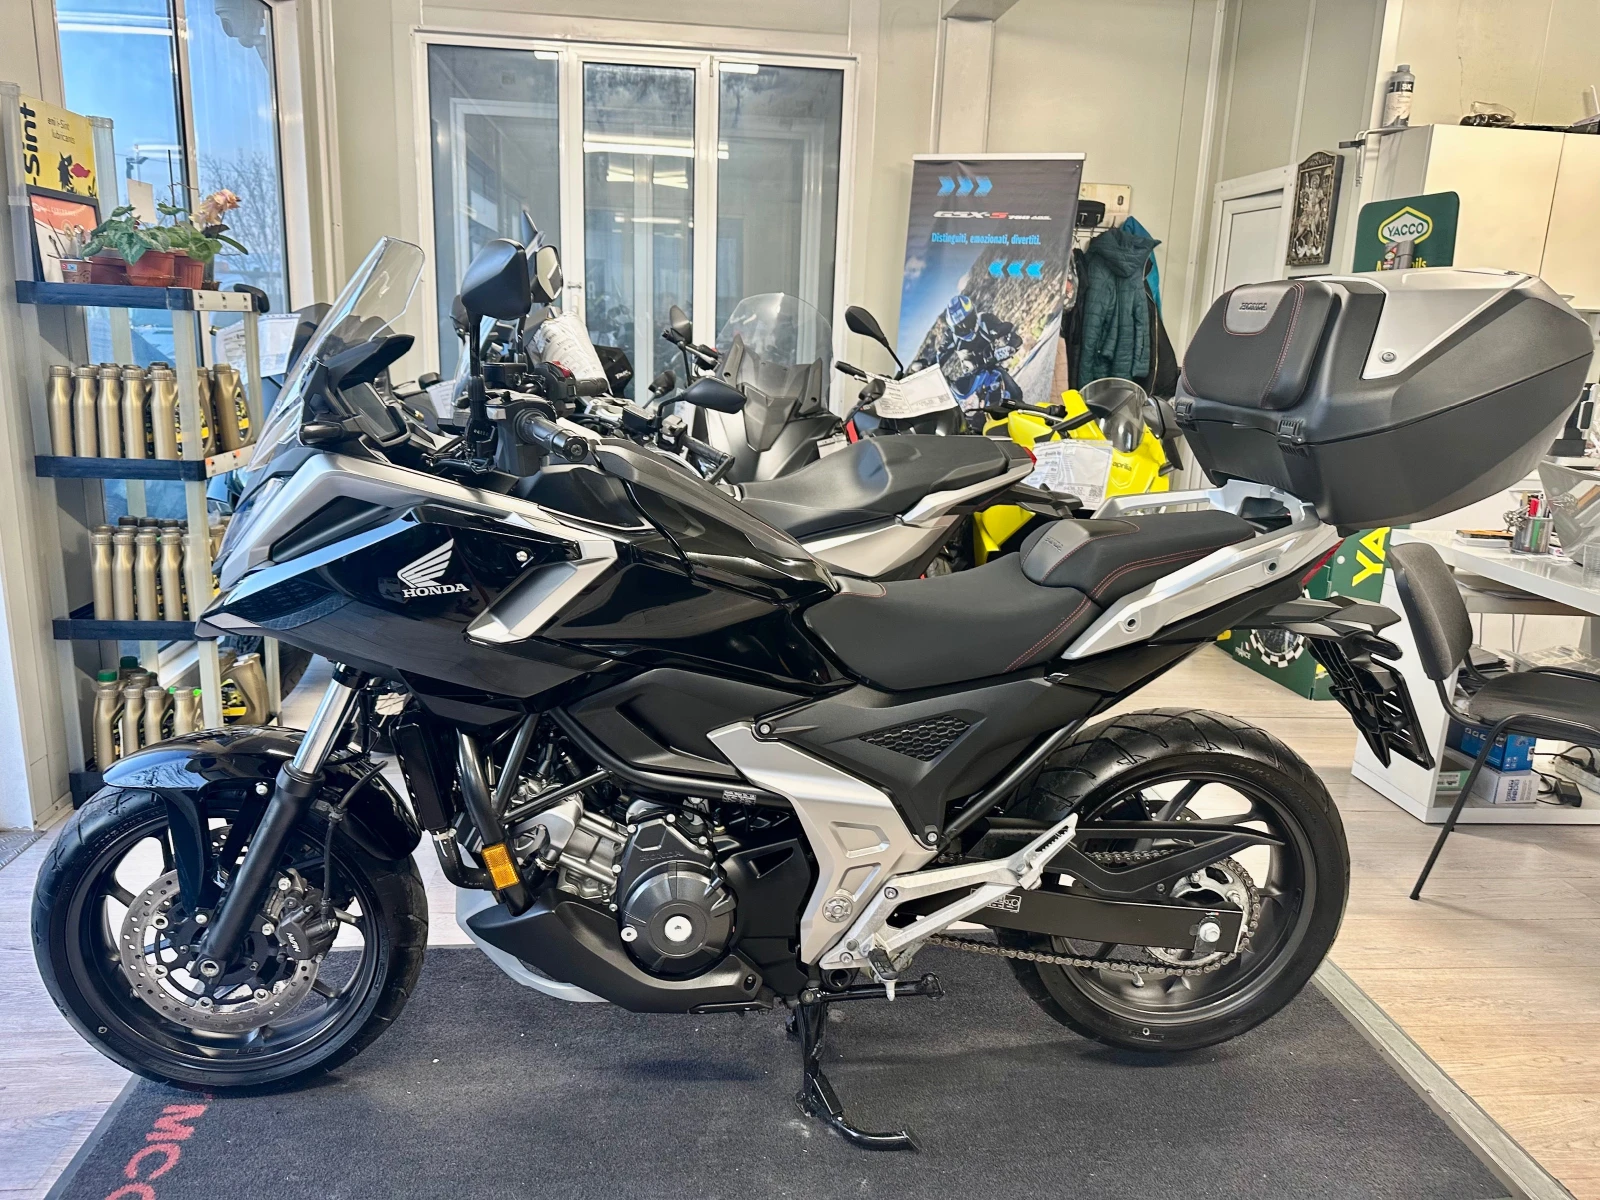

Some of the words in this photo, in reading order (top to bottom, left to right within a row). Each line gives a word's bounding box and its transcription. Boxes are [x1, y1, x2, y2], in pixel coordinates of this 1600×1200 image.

[1387, 222, 1425, 237] YACCO
[931, 232, 968, 245] Distinguiti,
[969, 233, 1010, 246] emozionati,
[1010, 234, 1042, 246] divertiti.
[1112, 460, 1133, 472] aprilia
[401, 583, 470, 598] HONDA
[639, 850, 685, 862] HONDA
[104, 1094, 211, 1200] MC
